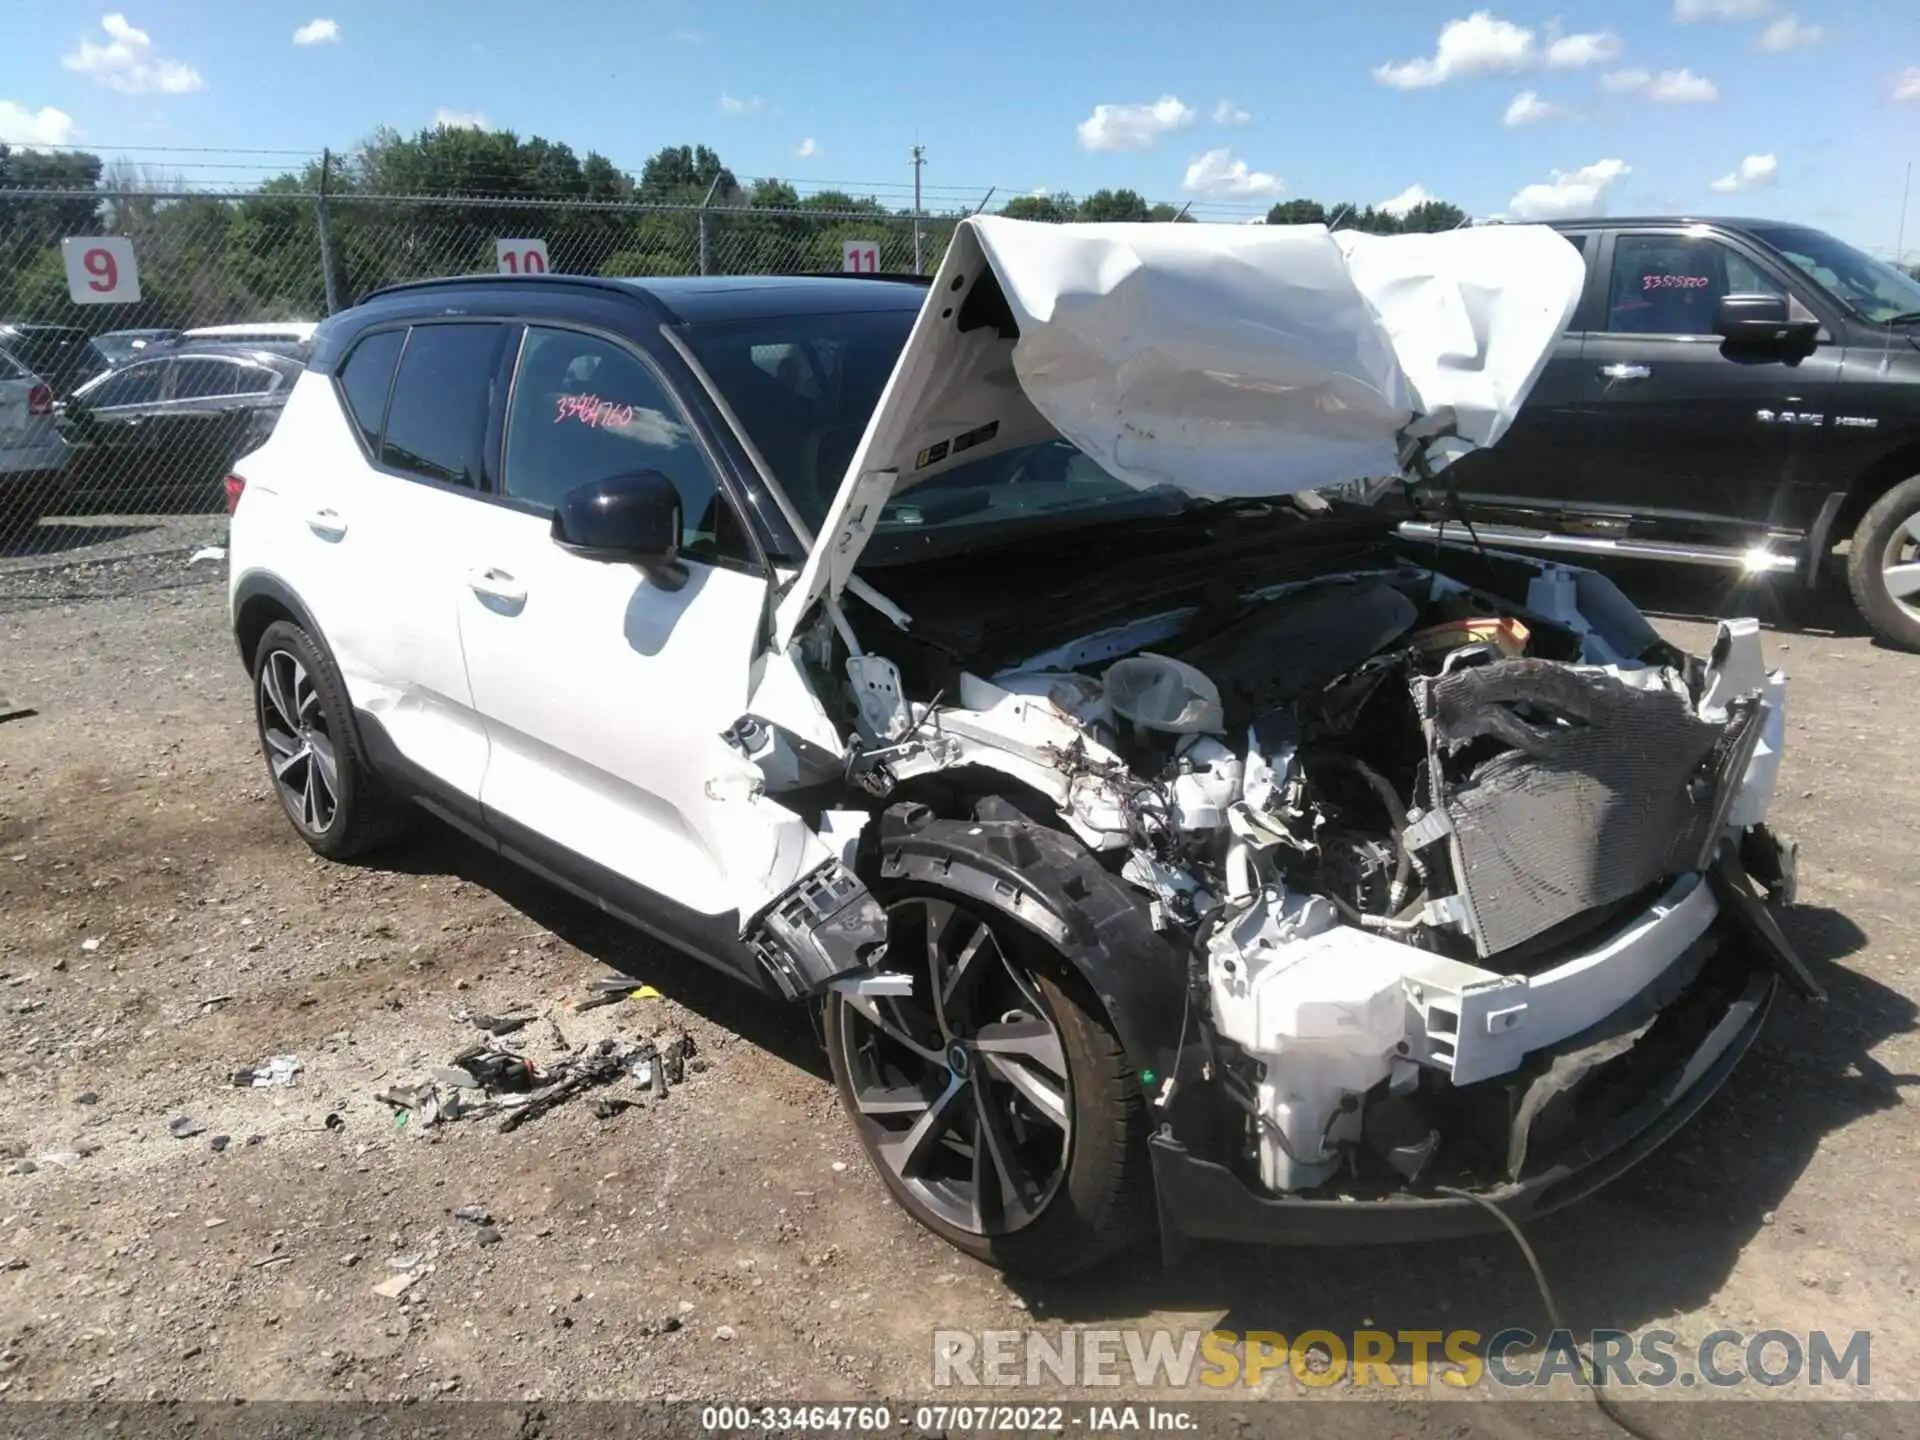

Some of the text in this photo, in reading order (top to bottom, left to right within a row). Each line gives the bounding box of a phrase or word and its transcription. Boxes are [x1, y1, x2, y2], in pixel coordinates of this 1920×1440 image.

[84, 248, 118, 292] 9
[502, 250, 545, 274] 10
[848, 249, 876, 273] 11
